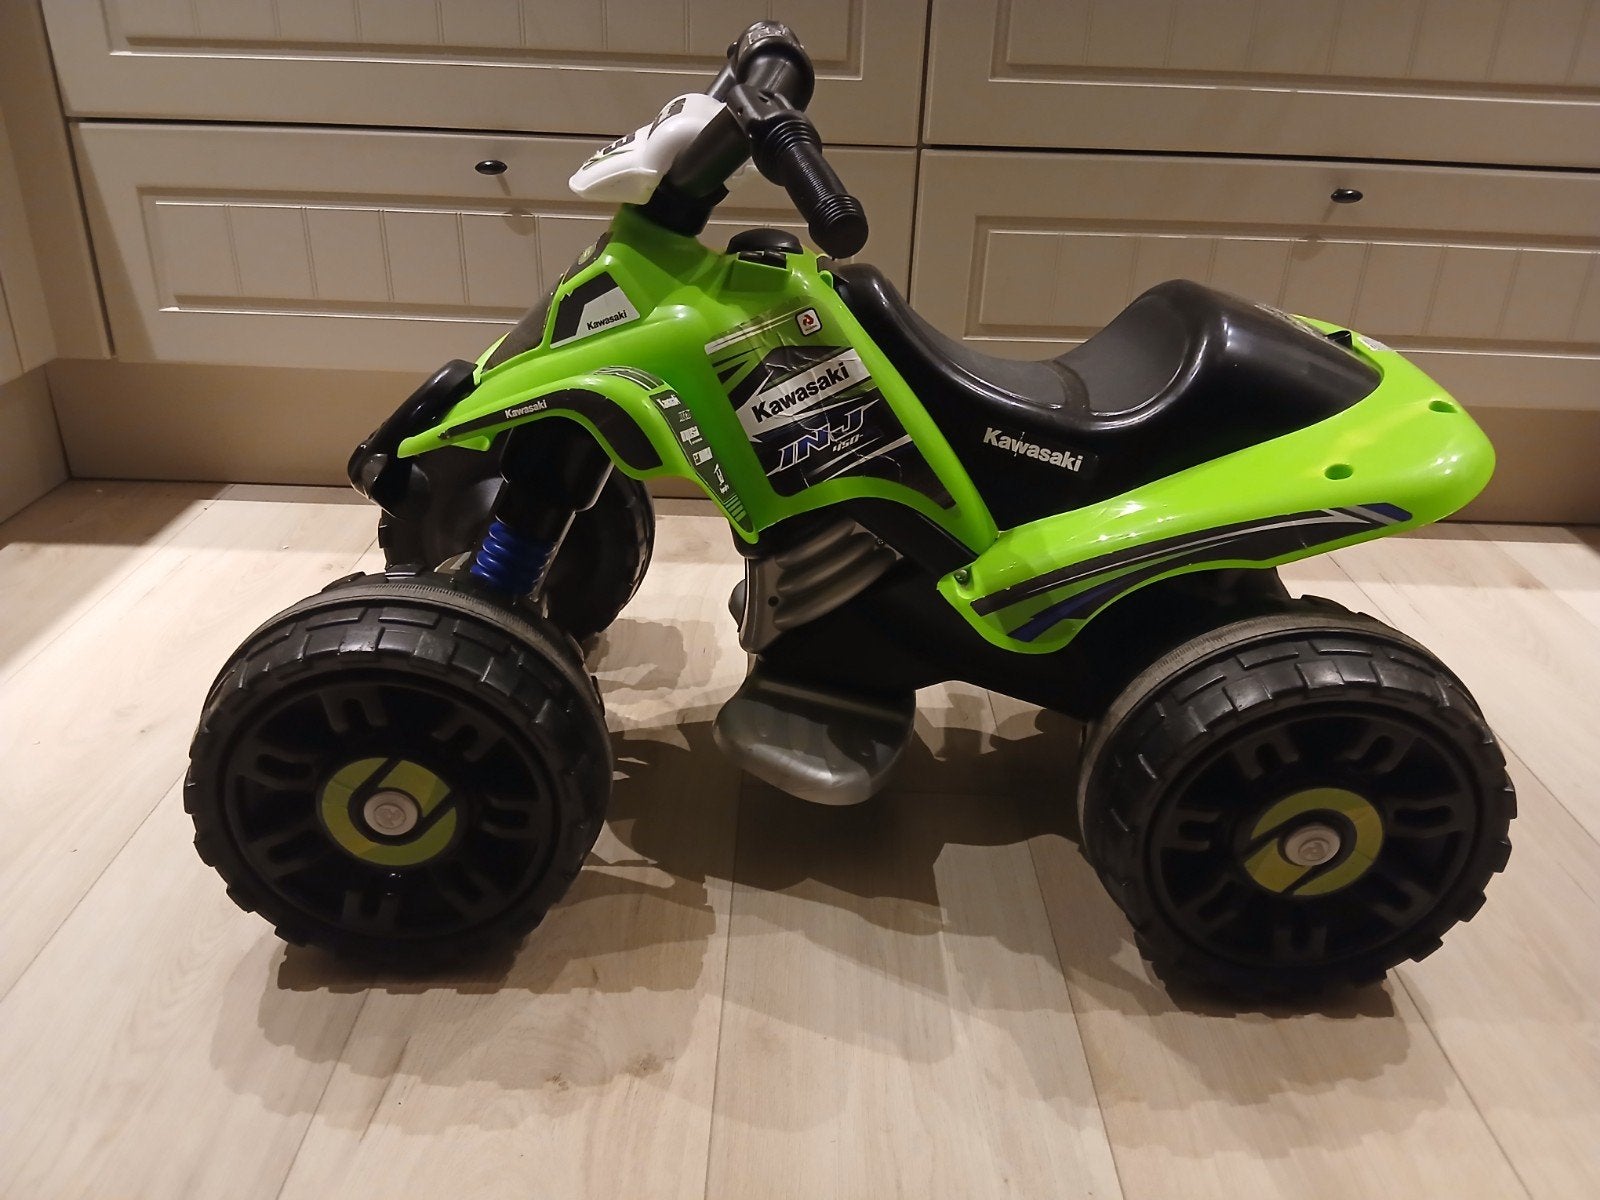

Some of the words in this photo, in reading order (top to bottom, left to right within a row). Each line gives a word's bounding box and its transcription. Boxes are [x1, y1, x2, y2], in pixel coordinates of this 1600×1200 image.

[587, 309, 628, 331] Kawasaki
[505, 400, 548, 418] Kawasaki
[752, 362, 850, 423] Kawasaki
[983, 427, 1083, 472] Kawasaki
